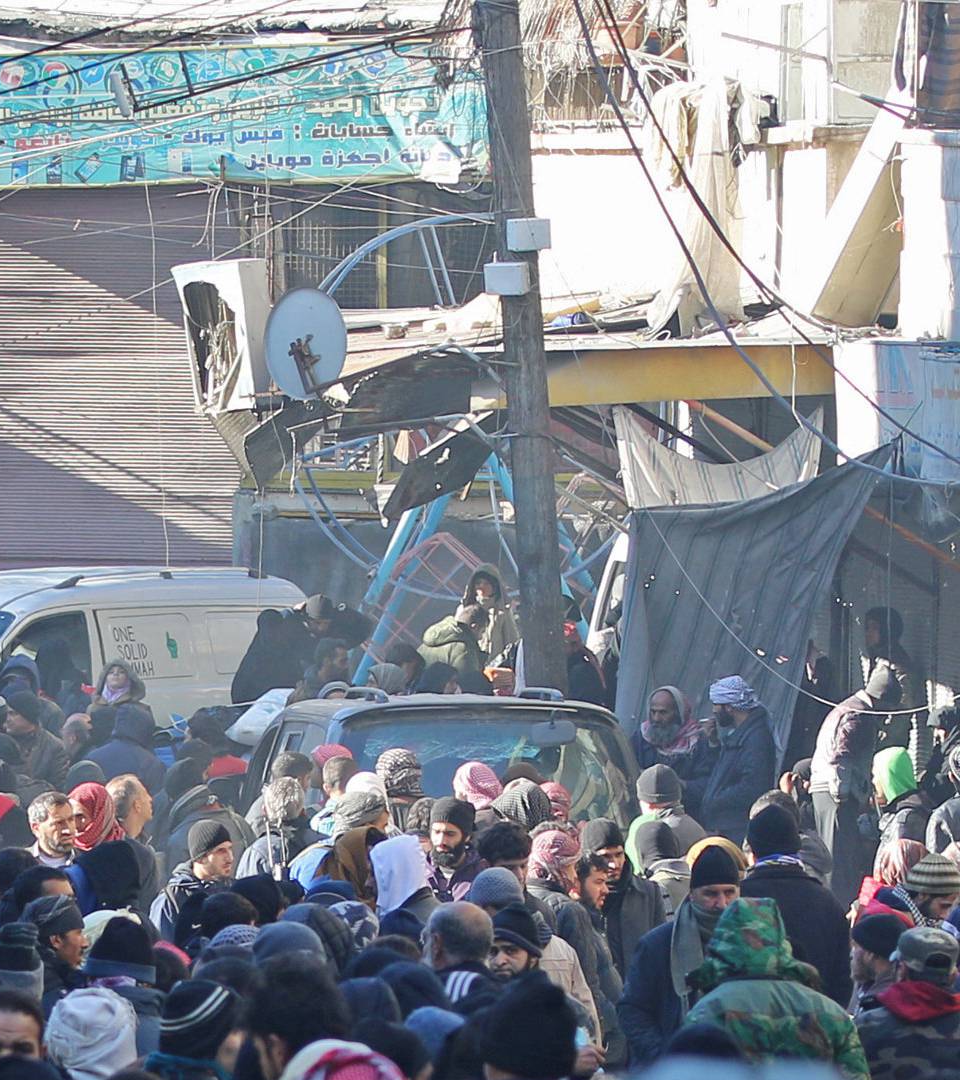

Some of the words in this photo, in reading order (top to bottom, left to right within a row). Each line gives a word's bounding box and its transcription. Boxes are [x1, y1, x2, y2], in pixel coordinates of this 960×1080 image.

[183, 130, 225, 144] بوك
[235, 126, 283, 143] فيس
[112, 626, 136, 642] ONE
[117, 643, 148, 660] SOLID
